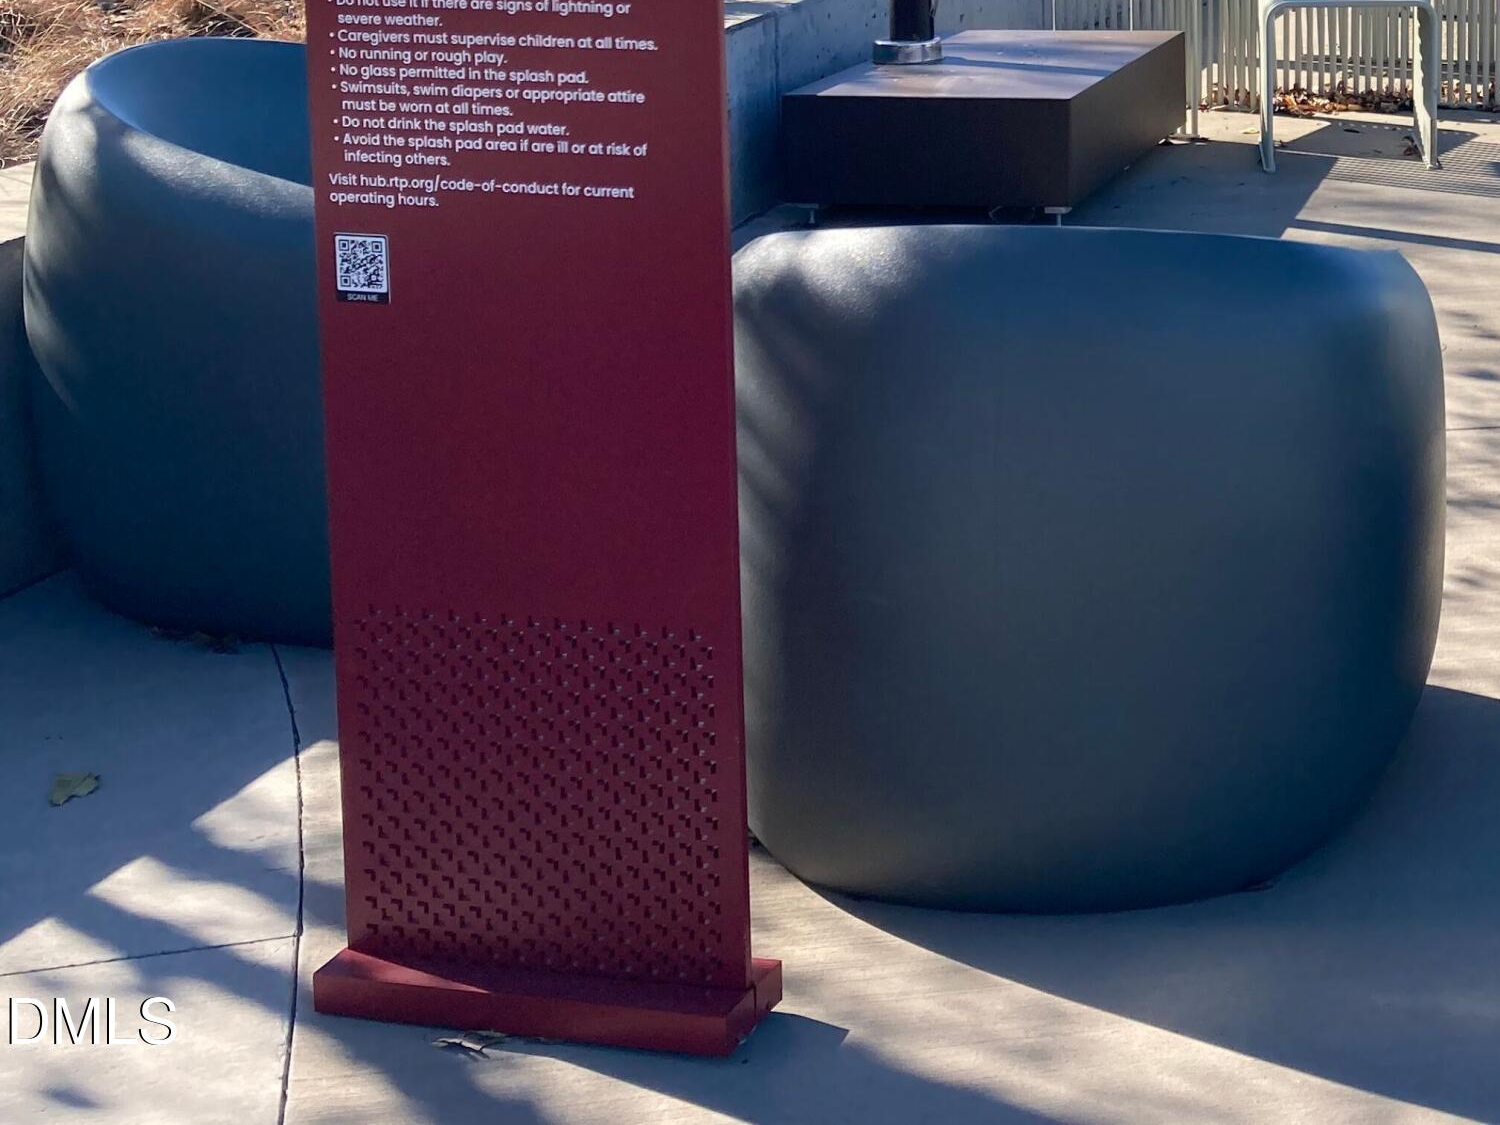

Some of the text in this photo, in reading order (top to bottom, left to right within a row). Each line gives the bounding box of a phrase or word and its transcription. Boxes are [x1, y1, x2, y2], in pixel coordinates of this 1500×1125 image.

[470, 0, 494, 10] are
[535, 0, 549, 11] of
[552, 0, 613, 17] lightning
[616, 4, 631, 14] or
[338, 14, 442, 26] severe weather.
[338, 29, 658, 50] Caregivers must supervise children at all times.
[339, 47, 508, 66] No running or rough play.
[340, 64, 589, 86] No glass permitted in the splash pad.
[340, 81, 646, 104] Swimsuits, swim diapers or appropriate attire
[342, 100, 513, 116] must be worn at all times.
[342, 116, 570, 136] Do not drink the splash pad water.
[343, 133, 647, 156] Avoid the splash pad area if are ill or at risk of
[344, 150, 450, 167] infecting others.
[329, 173, 634, 198] Visit hub.rtp.org/code-of-conduct for current
[330, 192, 439, 208] operating hours.
